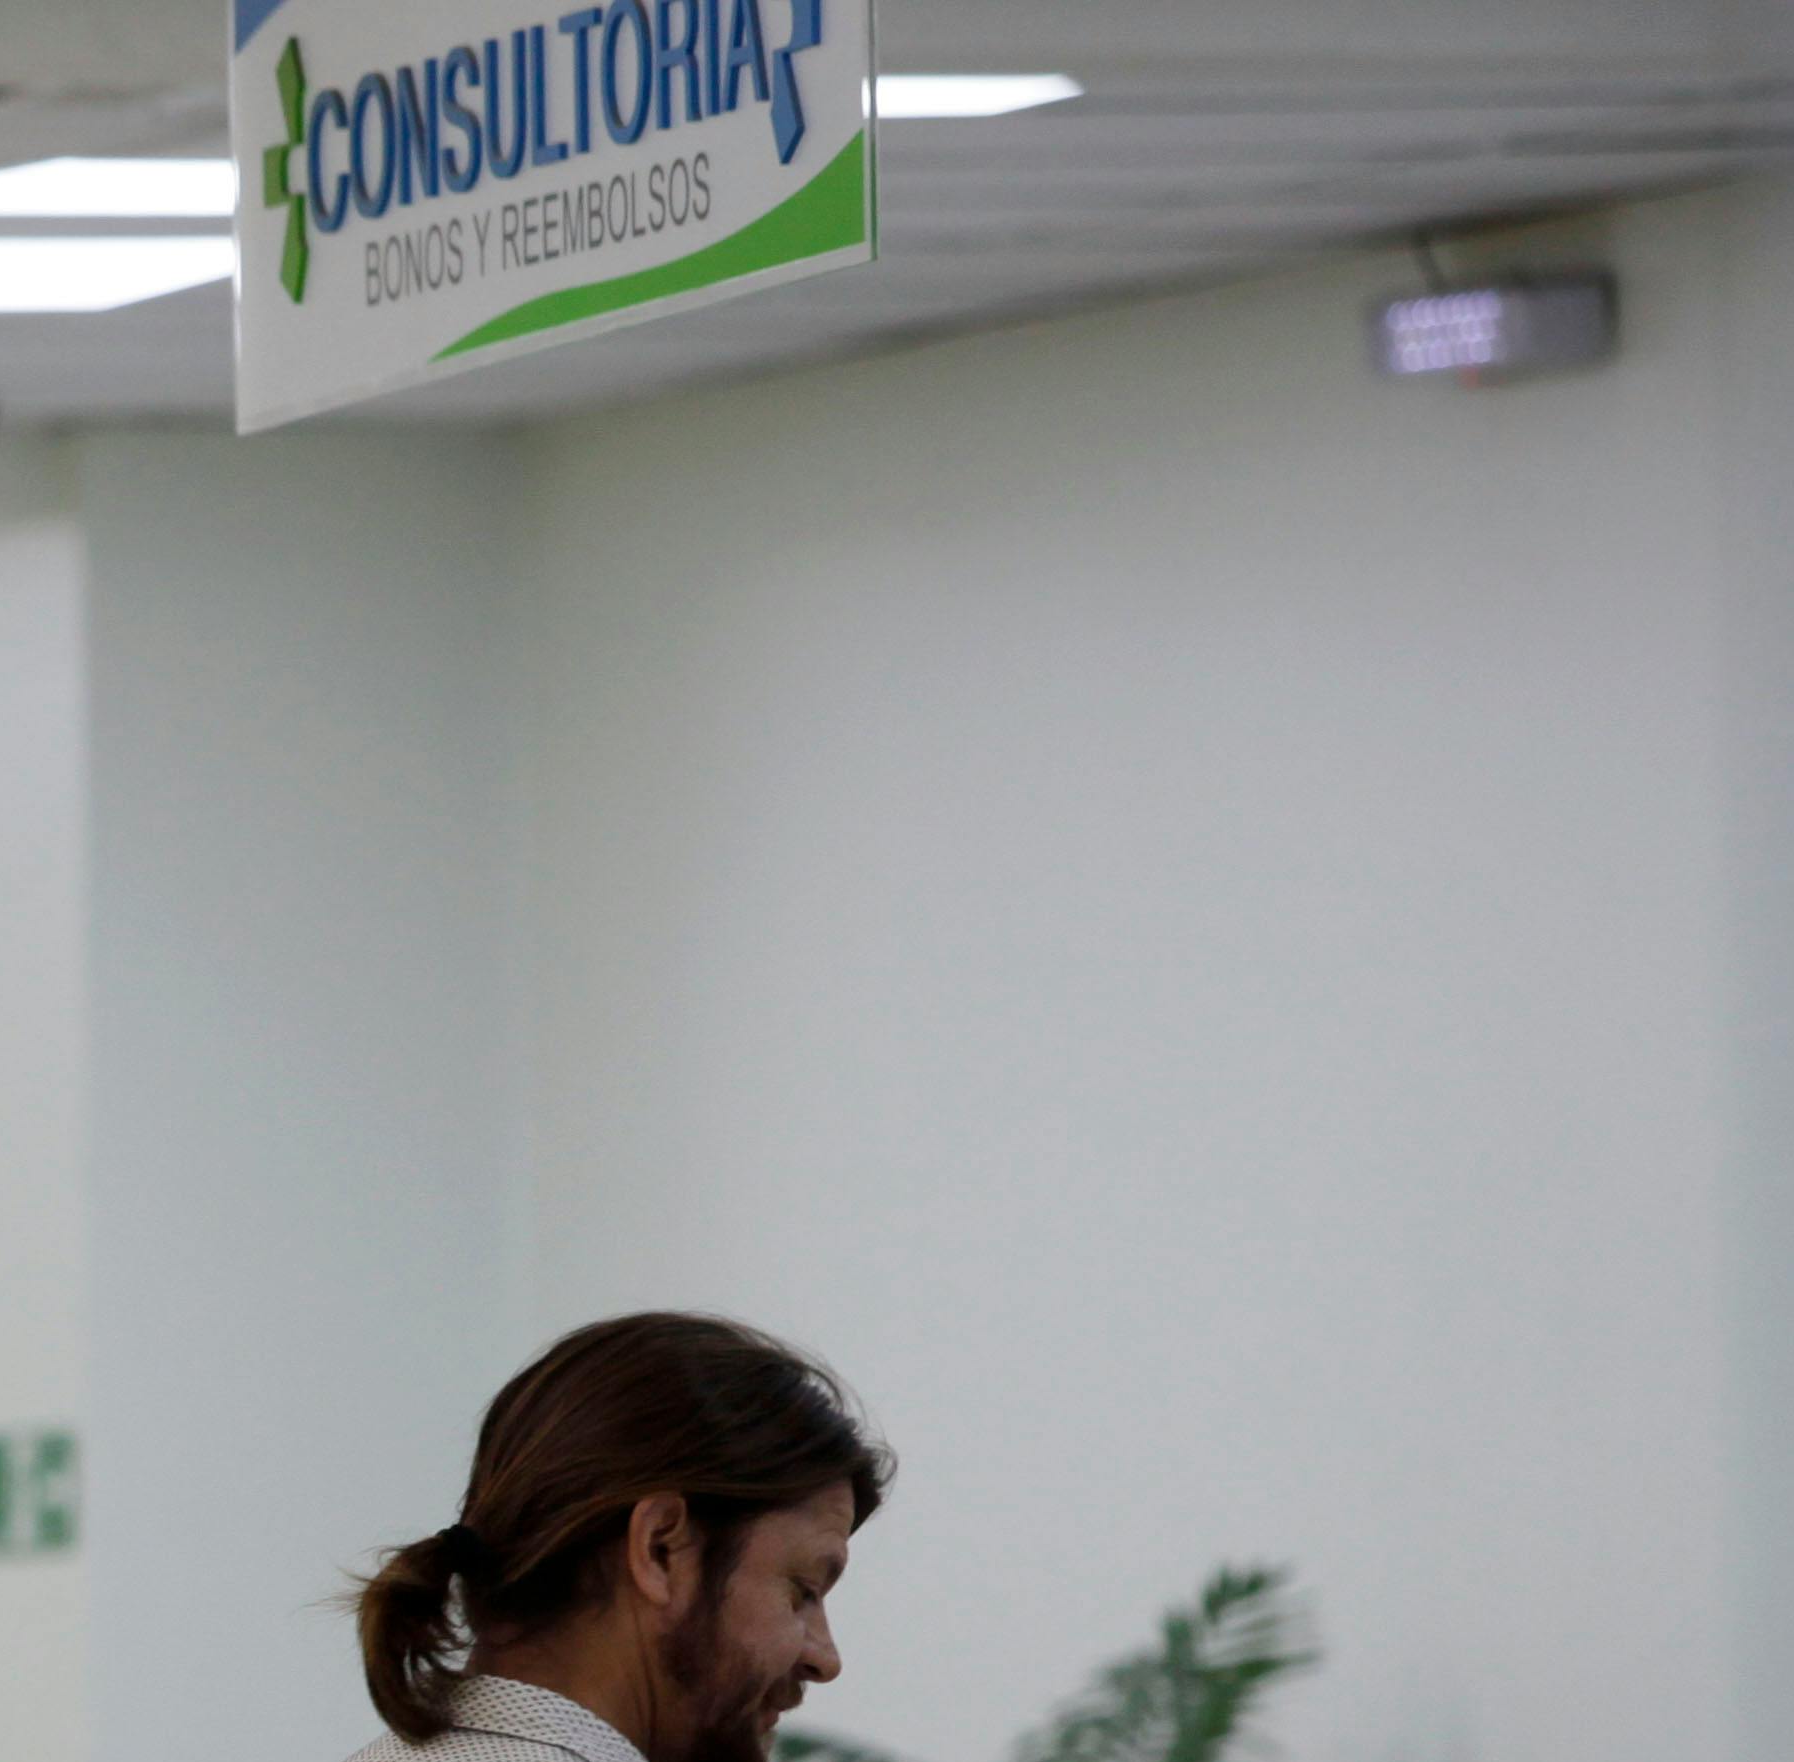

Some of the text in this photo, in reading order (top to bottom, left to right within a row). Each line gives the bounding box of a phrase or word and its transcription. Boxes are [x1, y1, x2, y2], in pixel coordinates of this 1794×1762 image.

[307, 0, 769, 234] CONSULTORIA
[365, 151, 711, 306] BONOS Y REEMBOLSOS
